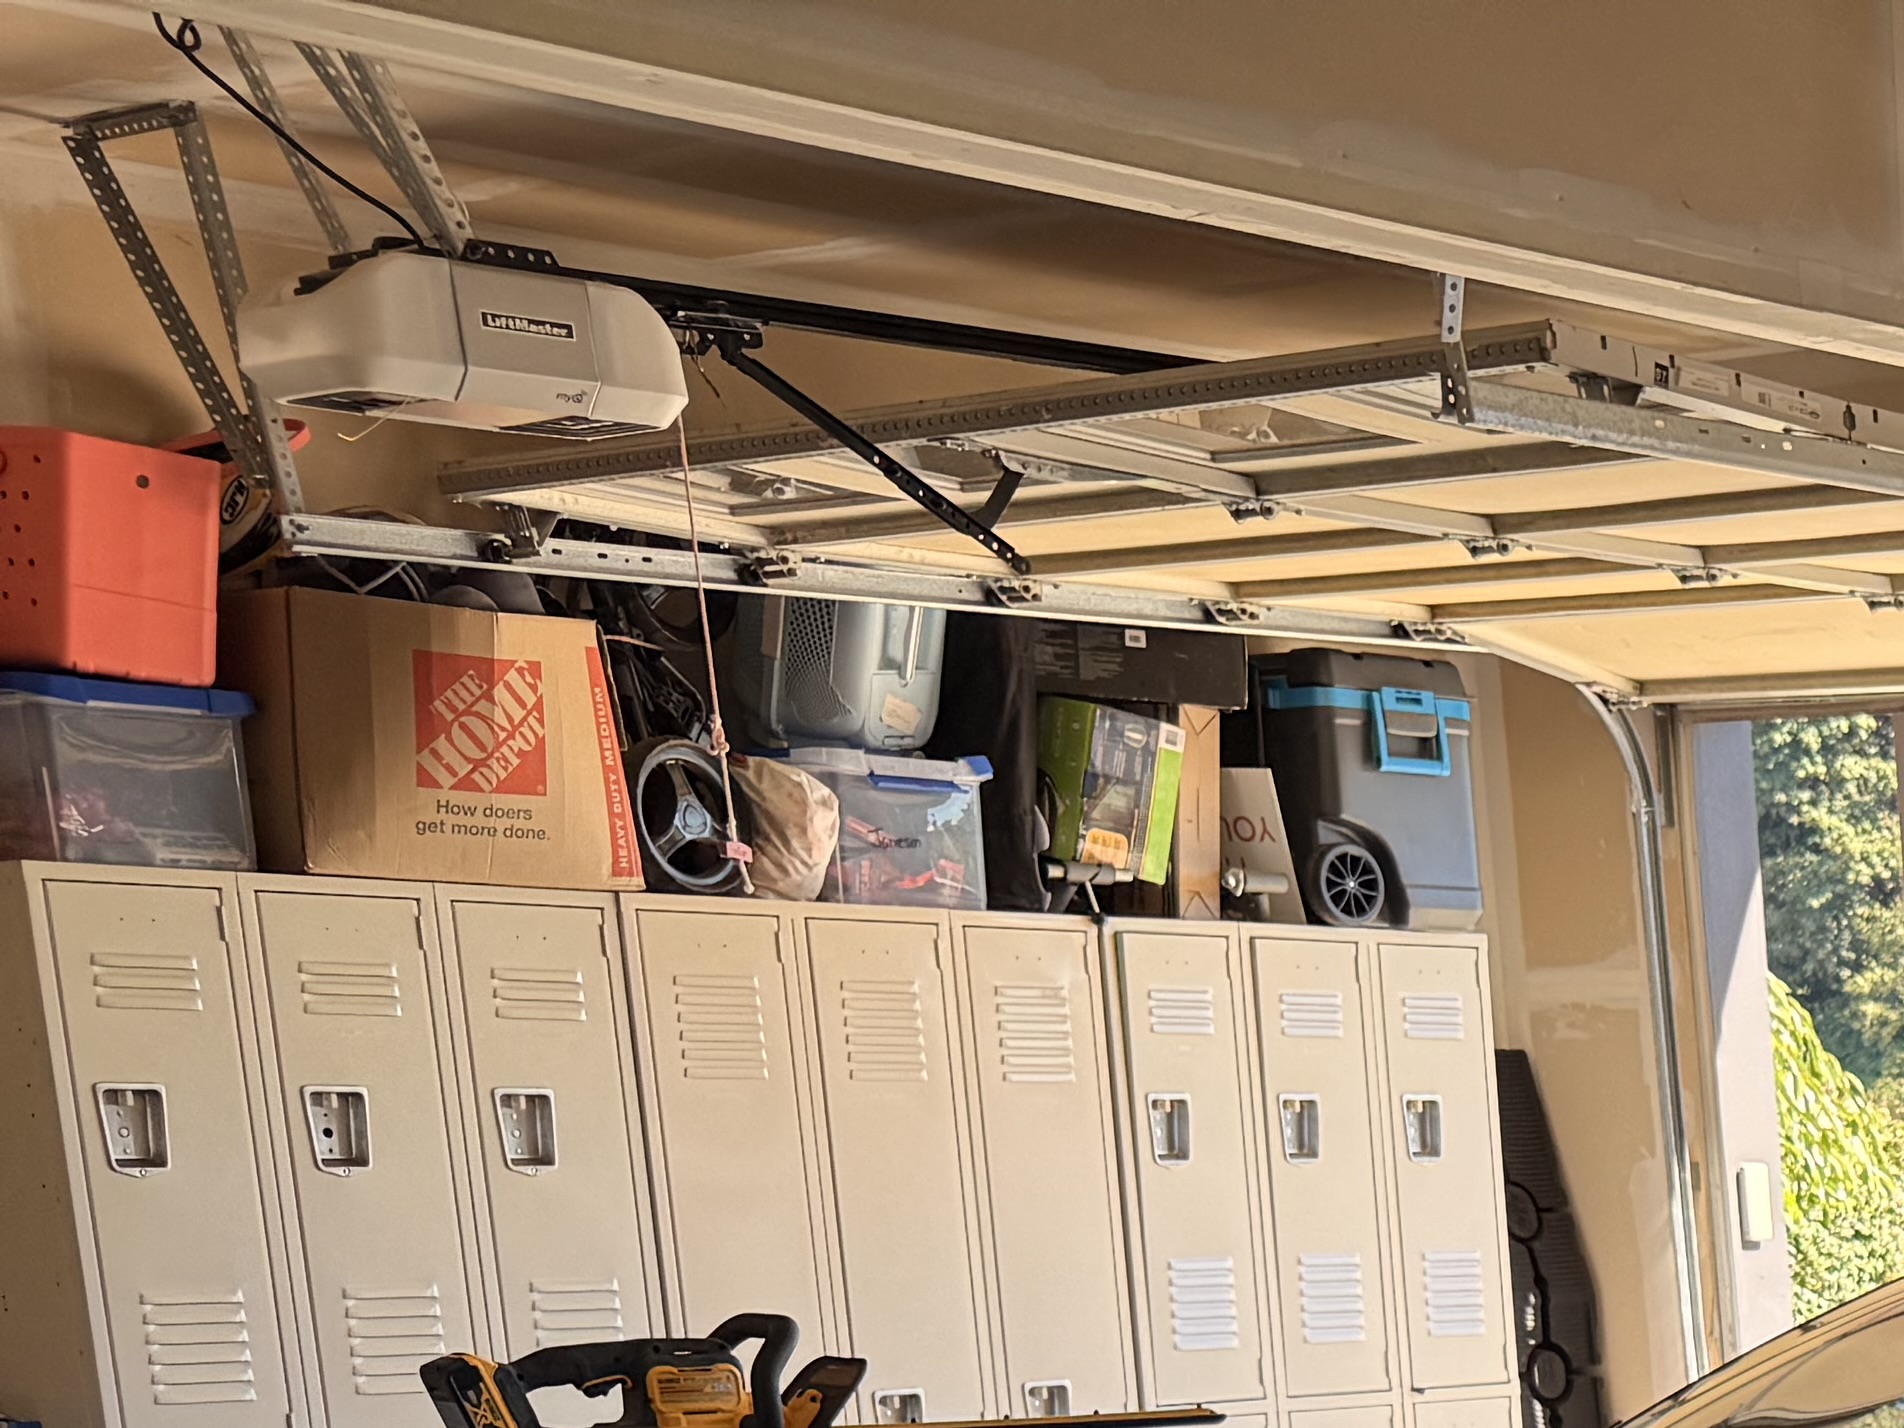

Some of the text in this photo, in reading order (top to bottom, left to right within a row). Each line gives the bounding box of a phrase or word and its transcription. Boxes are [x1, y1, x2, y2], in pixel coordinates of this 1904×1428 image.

[485, 313, 569, 337] LiftMaster
[429, 669, 488, 722] THE
[415, 659, 544, 791] HOME
[470, 711, 545, 793] DEPOT
[593, 686, 630, 867] HEAVY DUTY MEDIUM
[415, 818, 551, 841] get more done.
[436, 799, 533, 821] How doers
